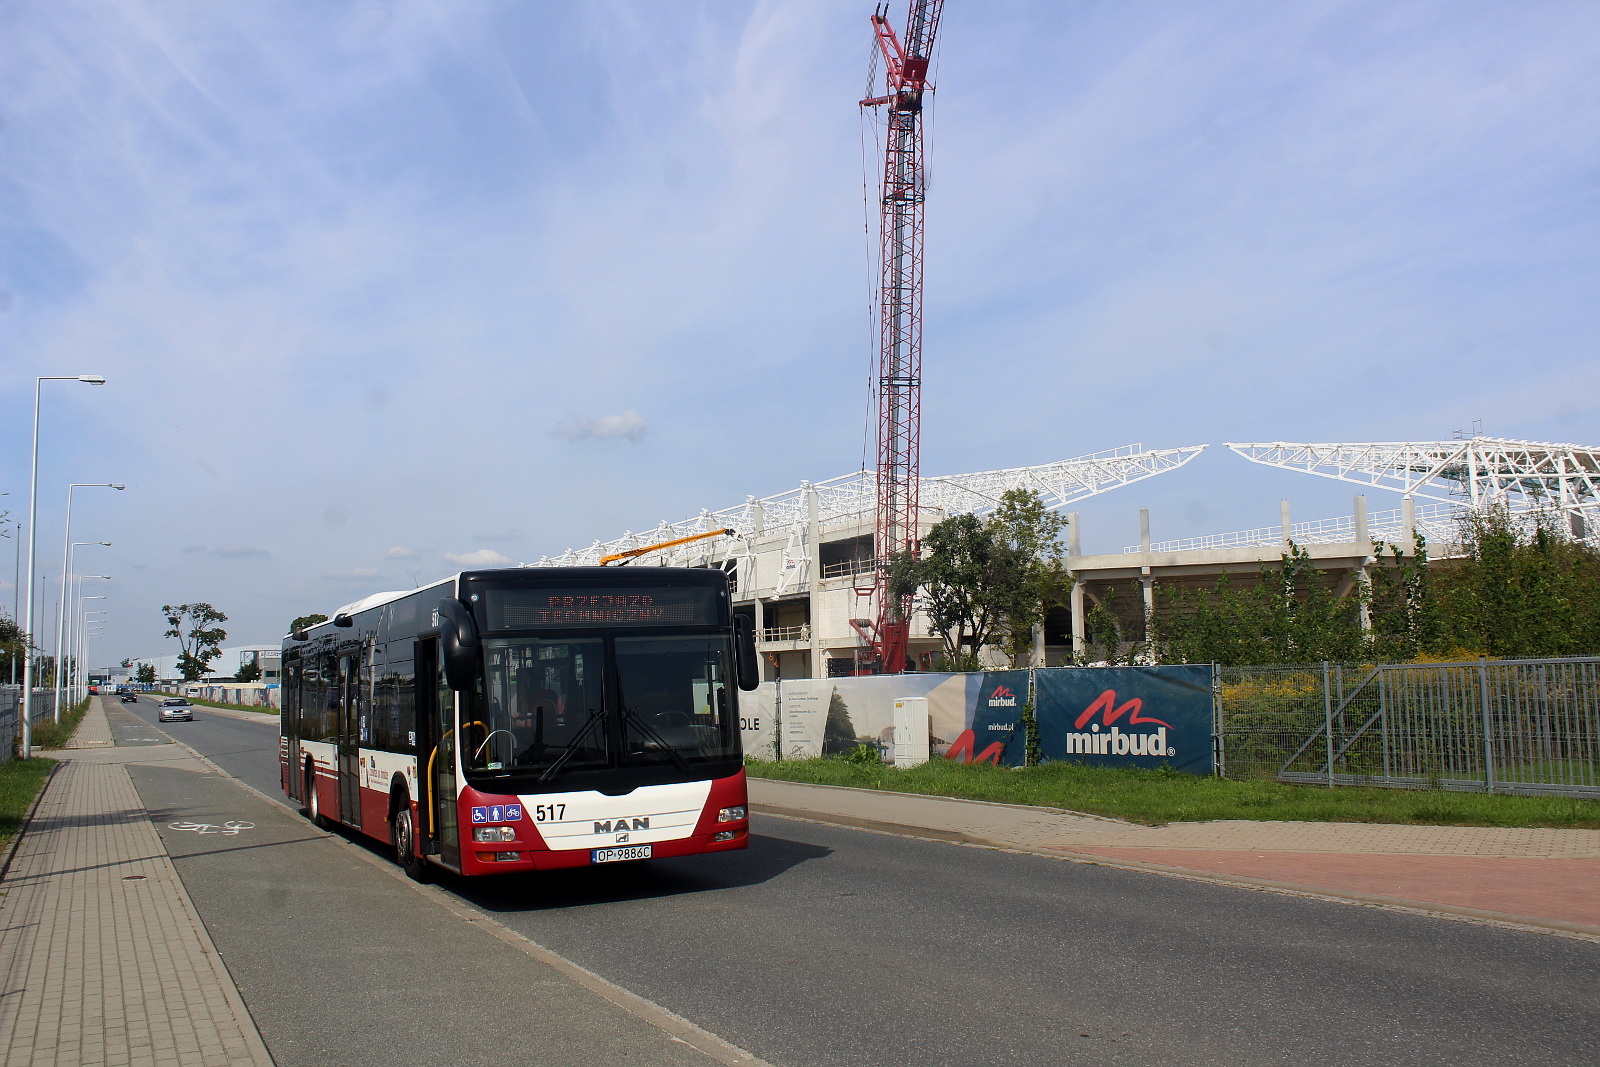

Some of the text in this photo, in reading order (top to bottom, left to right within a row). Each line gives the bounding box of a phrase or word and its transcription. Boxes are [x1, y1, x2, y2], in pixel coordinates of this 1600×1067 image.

[548, 595, 654, 608] PRZEJAZD
[988, 722, 1014, 732] mirbud.pl
[536, 803, 566, 822] 517
[593, 816, 650, 834] MAN
